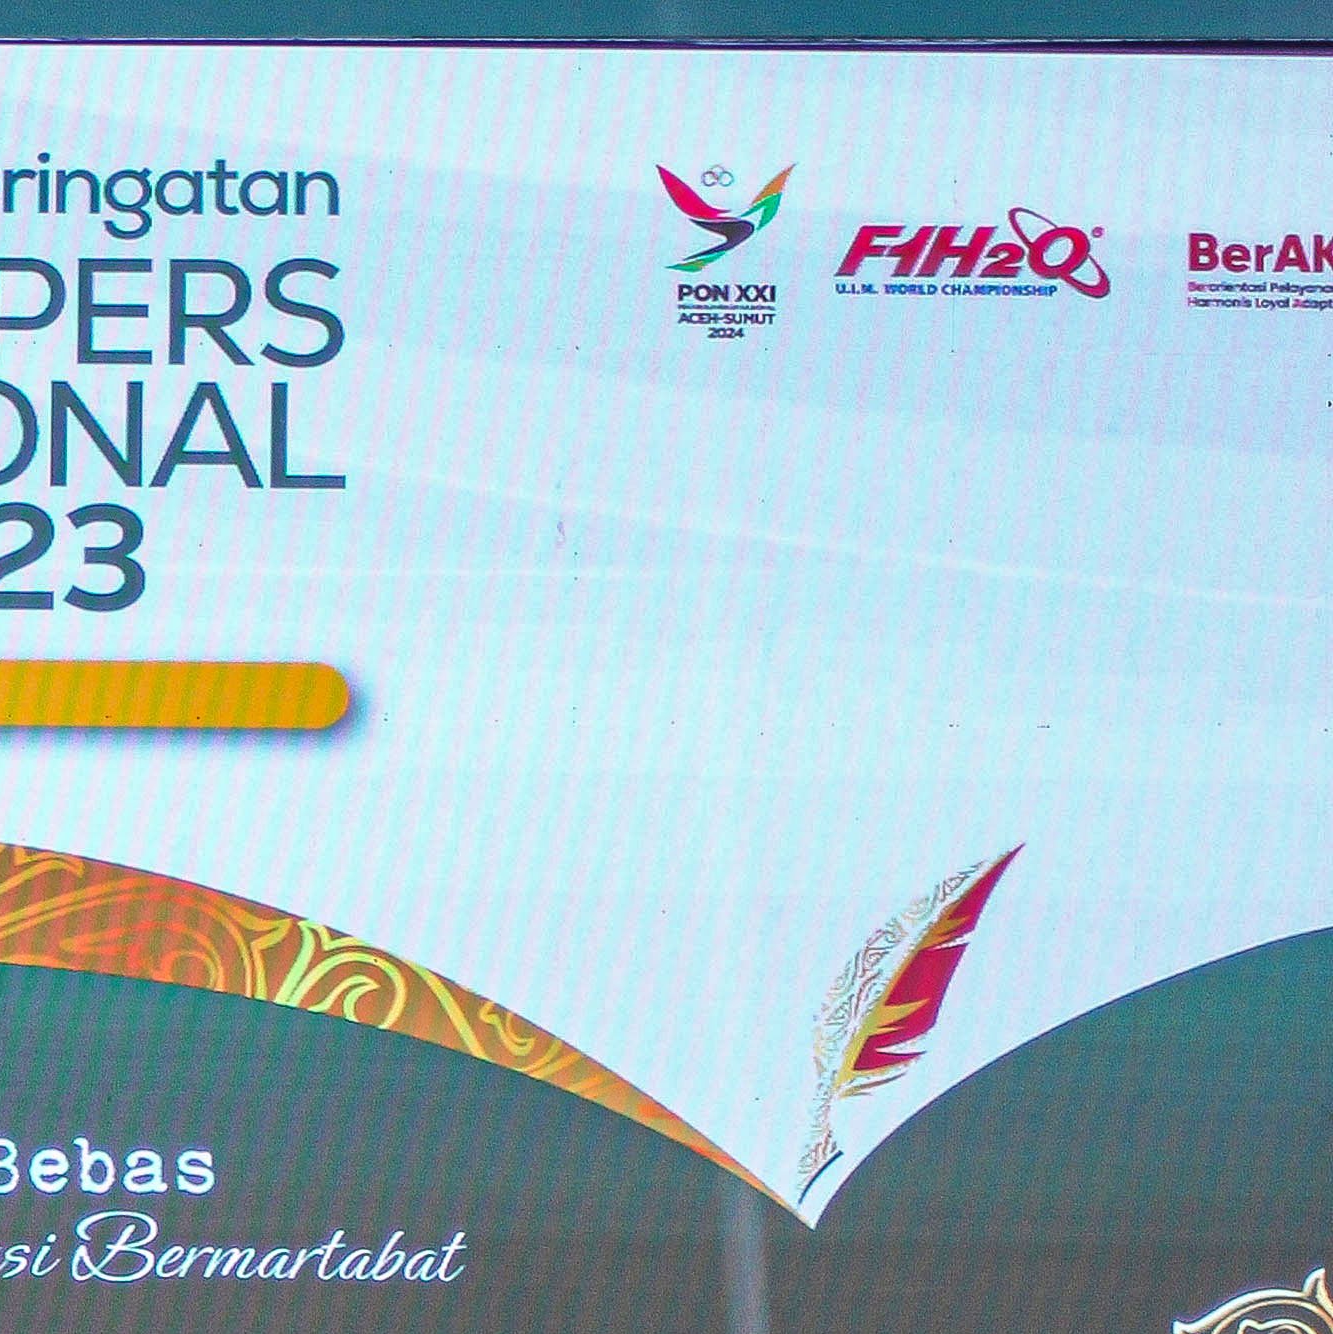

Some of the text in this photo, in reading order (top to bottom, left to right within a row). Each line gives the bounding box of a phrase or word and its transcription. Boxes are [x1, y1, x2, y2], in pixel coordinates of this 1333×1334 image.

[677, 283, 776, 303] PON XXI
[707, 327, 745, 339] 2024
[71, 1210, 468, 1283] Bermartabat
